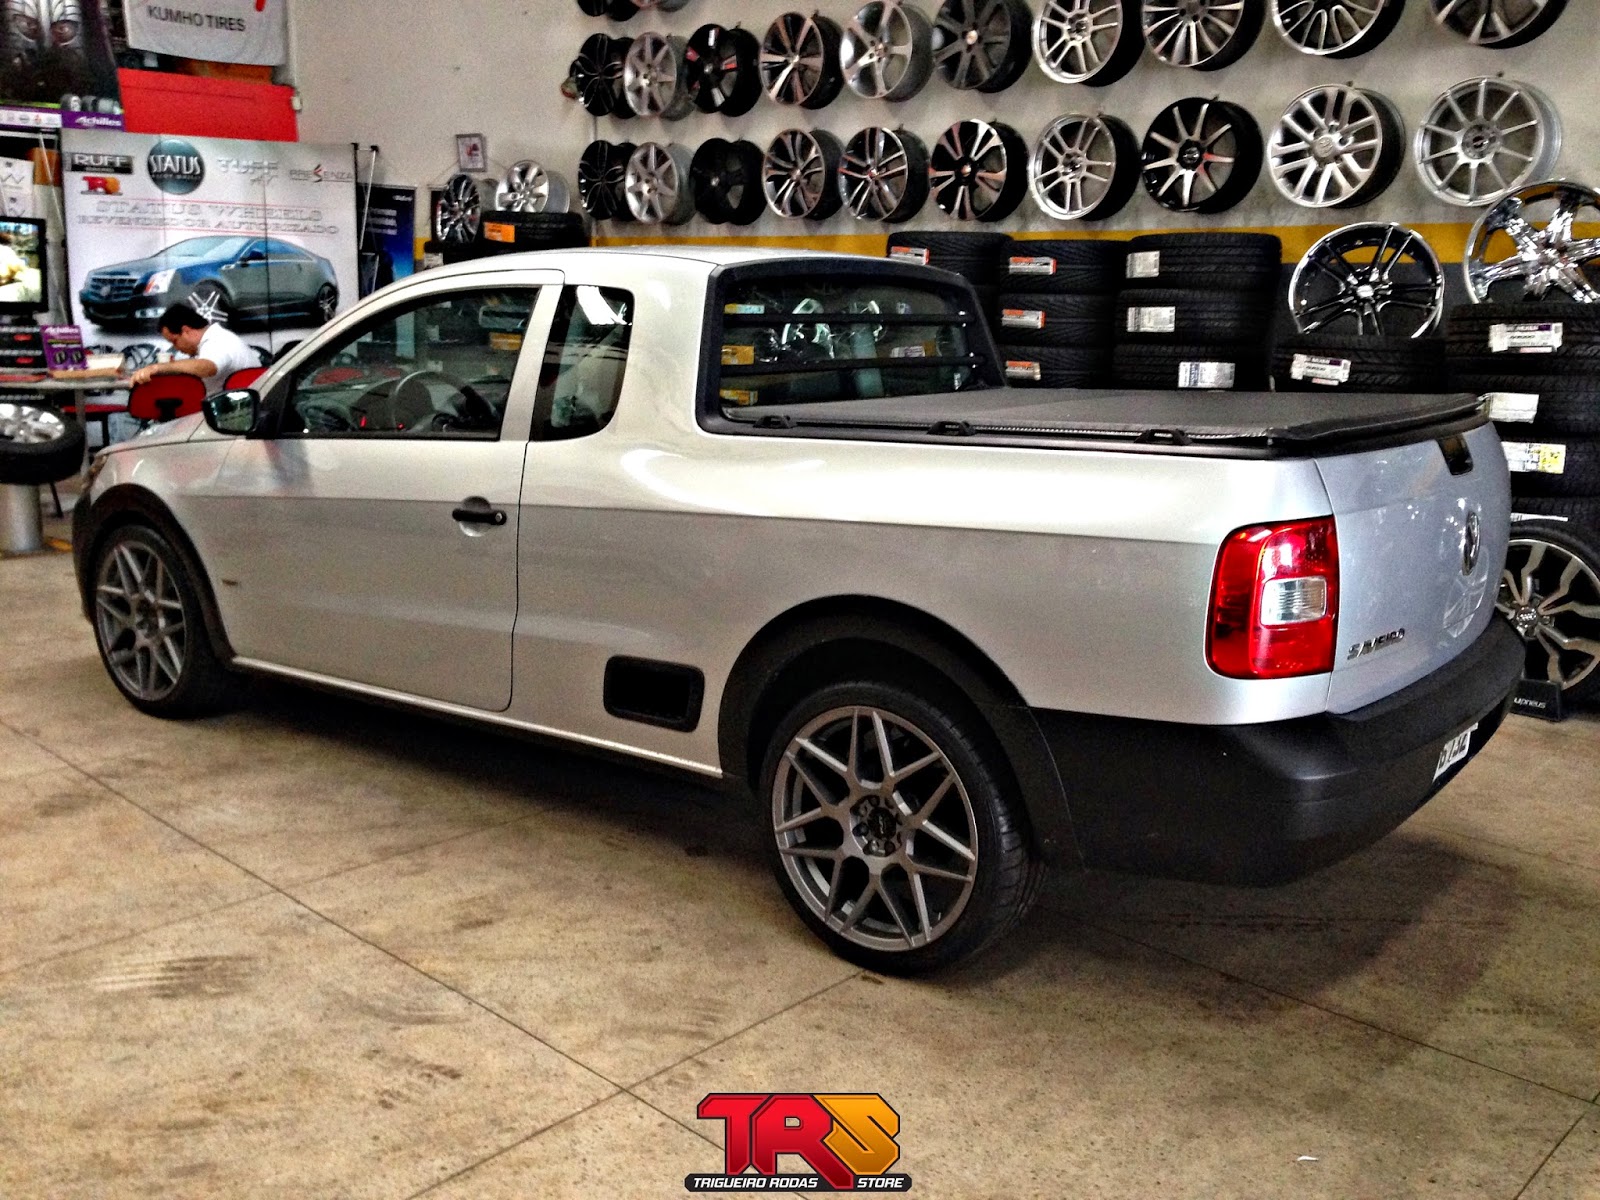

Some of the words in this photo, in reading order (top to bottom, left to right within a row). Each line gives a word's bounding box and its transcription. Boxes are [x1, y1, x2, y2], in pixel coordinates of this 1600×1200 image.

[147, 5, 204, 27] KUMHO
[205, 14, 247, 32] TIRES
[73, 152, 128, 168] RUFF
[149, 154, 201, 175] STATUS
[96, 200, 202, 216] STATUS
[207, 204, 323, 222] WHEELS
[213, 220, 340, 235] AUTORIZADO
